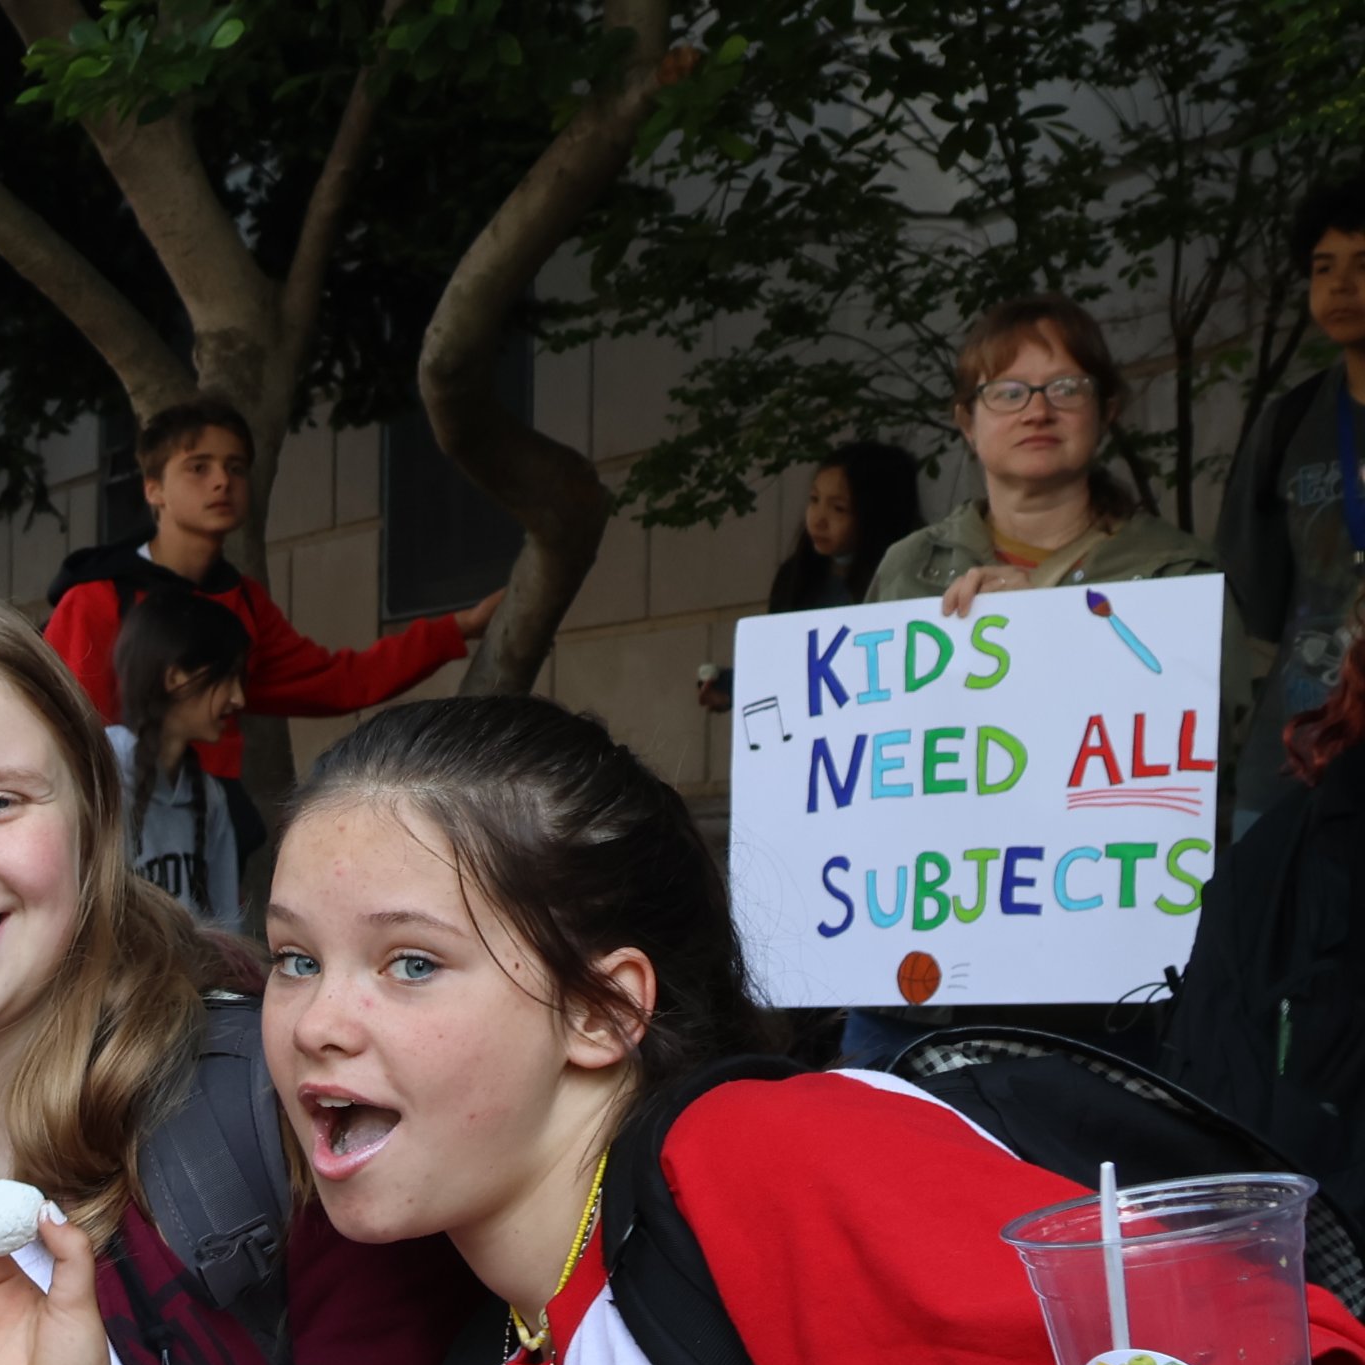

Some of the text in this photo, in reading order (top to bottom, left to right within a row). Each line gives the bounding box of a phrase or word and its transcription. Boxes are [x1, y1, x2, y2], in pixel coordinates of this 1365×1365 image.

[806, 614, 1011, 717] KIDS
[806, 709, 1218, 813] NEED ALL
[816, 838, 1214, 938] SUBJECTS
